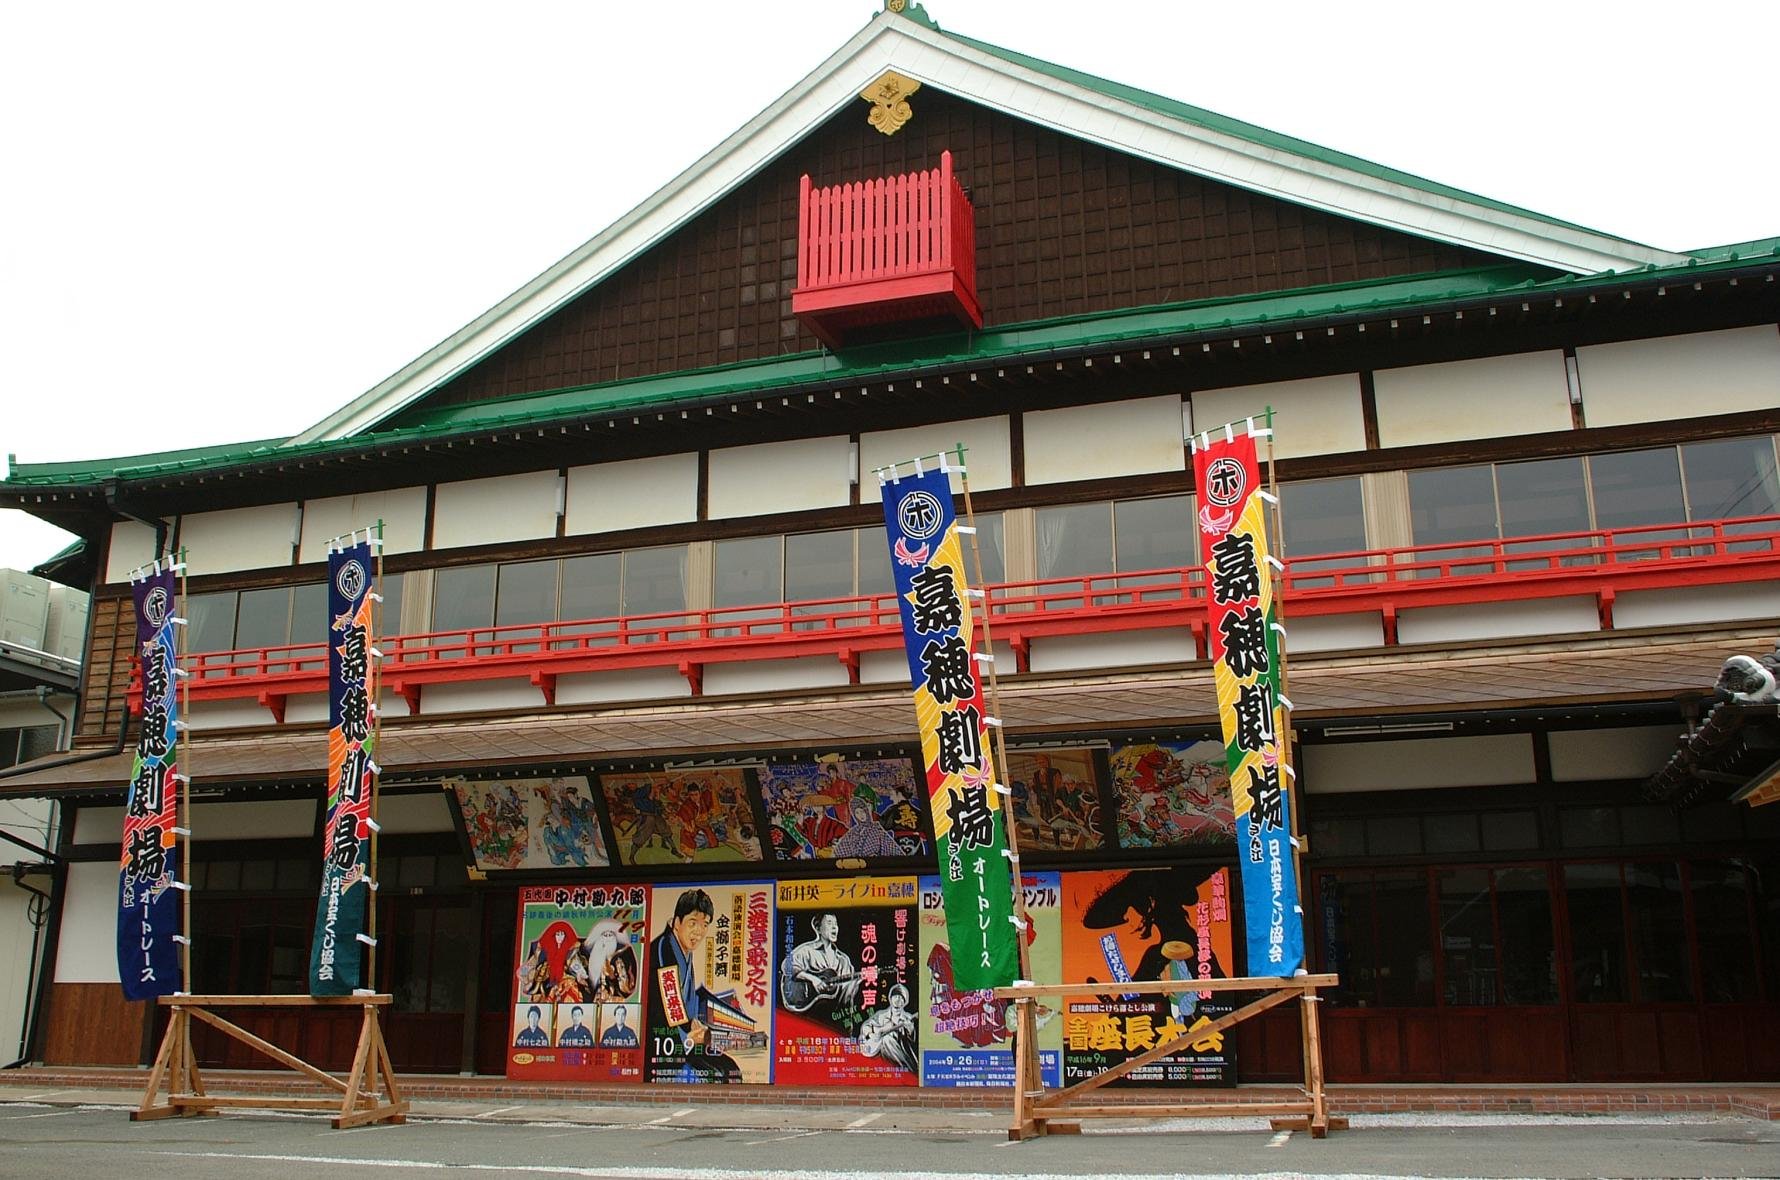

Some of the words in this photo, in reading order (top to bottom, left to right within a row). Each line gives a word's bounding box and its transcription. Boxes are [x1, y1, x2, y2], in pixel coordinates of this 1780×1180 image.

[909, 565, 996, 850] 嘉穂劇場
[1211, 531, 1284, 834] 嘉穂劇場
[129, 647, 167, 882] 嘉穂劇場
[140, 888, 157, 982] オートレース
[318, 876, 340, 980] 日本宝くじ協会
[555, 887, 645, 909] 中村勘九郎
[744, 891, 769, 1007] 三遊亭歌之介
[972, 855, 991, 968] オートレース
[1268, 838, 1285, 963] 日本宝くじ協会
